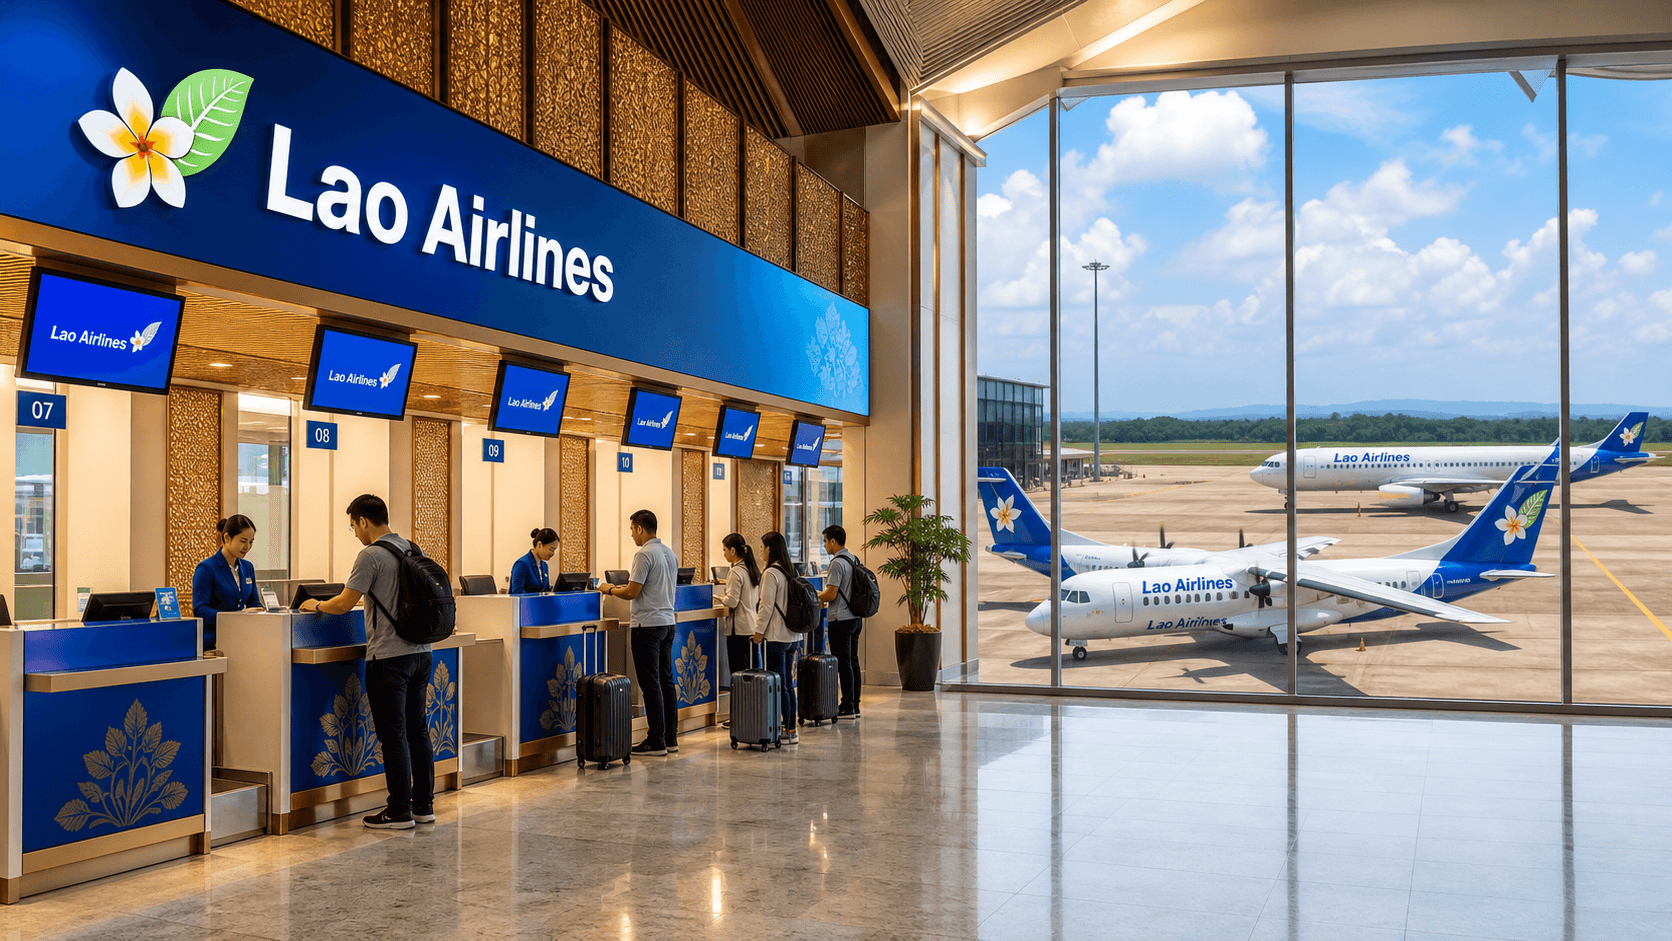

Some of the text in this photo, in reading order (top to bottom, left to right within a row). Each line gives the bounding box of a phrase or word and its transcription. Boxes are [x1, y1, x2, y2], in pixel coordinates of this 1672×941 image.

[266, 123, 614, 303] Lao Airlines
[50, 325, 128, 350] Lao Airlines
[328, 369, 378, 387] Lao Airlines
[31, 400, 54, 420] 07
[315, 427, 330, 444] 08
[488, 444, 500, 457] 09
[1333, 452, 1411, 463] Lao Airlines
[622, 456, 630, 468] 10
[1142, 576, 1234, 594] Lao Airlines
[1146, 620, 1173, 630] Lao
